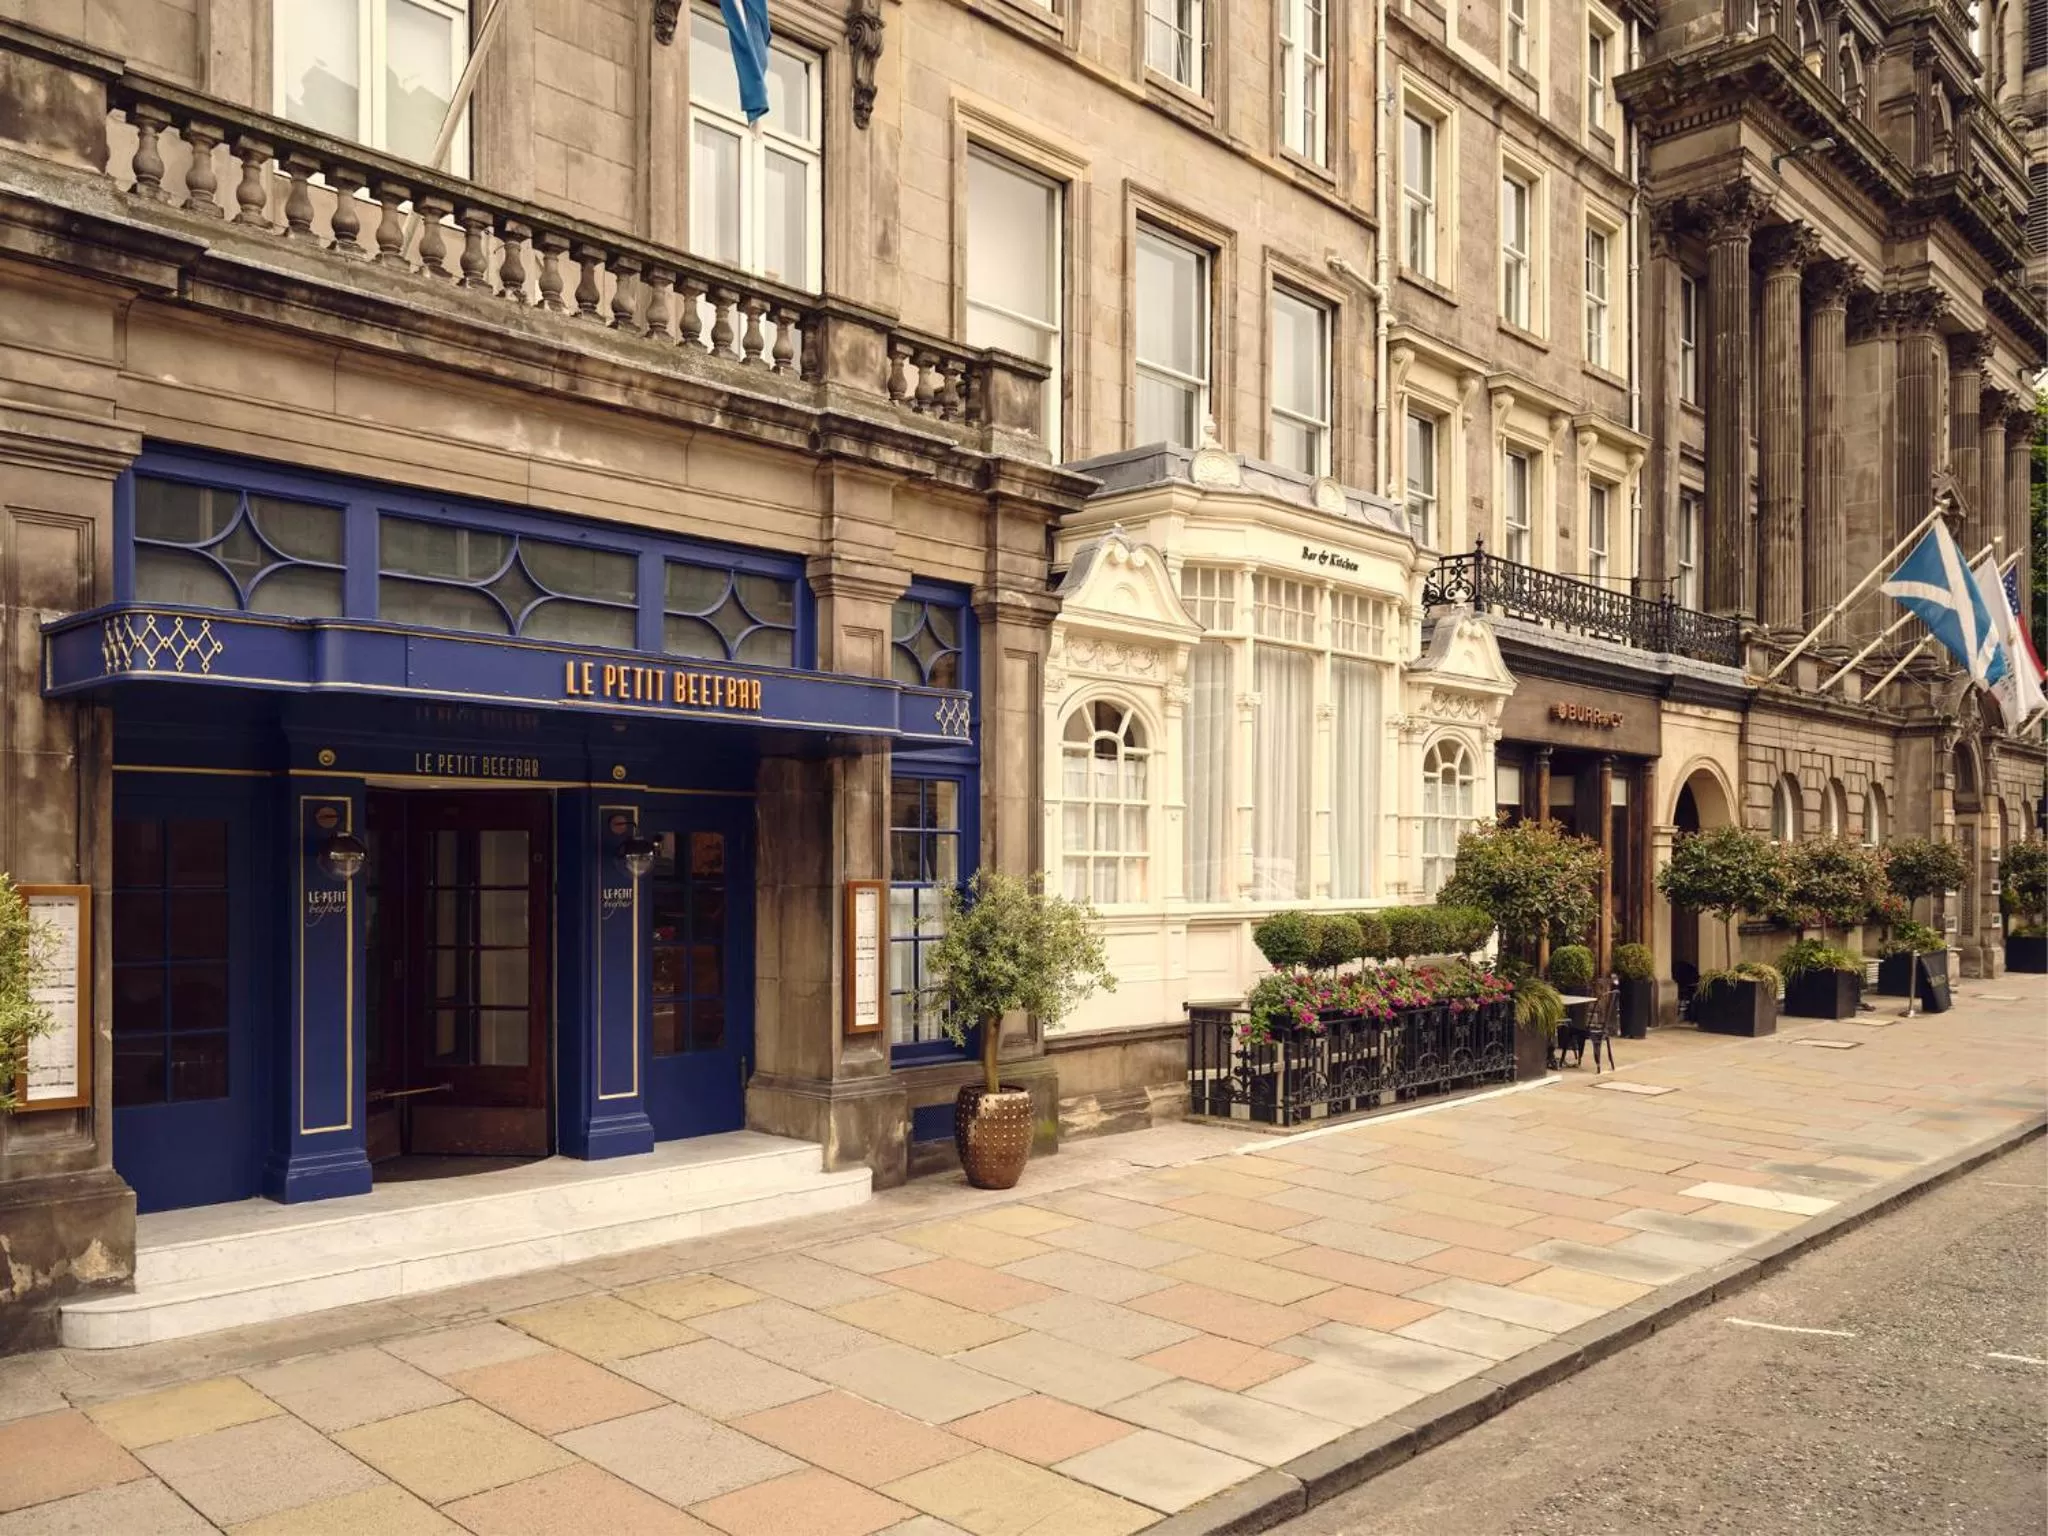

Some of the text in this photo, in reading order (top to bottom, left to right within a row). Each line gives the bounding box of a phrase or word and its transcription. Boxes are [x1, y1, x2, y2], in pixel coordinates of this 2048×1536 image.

[1302, 546, 1359, 571] Bar & Kitchen
[565, 659, 762, 710] LE PETIT BEEFBAR
[1568, 703, 1601, 723] BURR
[415, 752, 539, 778] LE PETIT BEEFBAR
[308, 890, 346, 903] LE PETIT
[603, 888, 633, 899] LE PETIT
